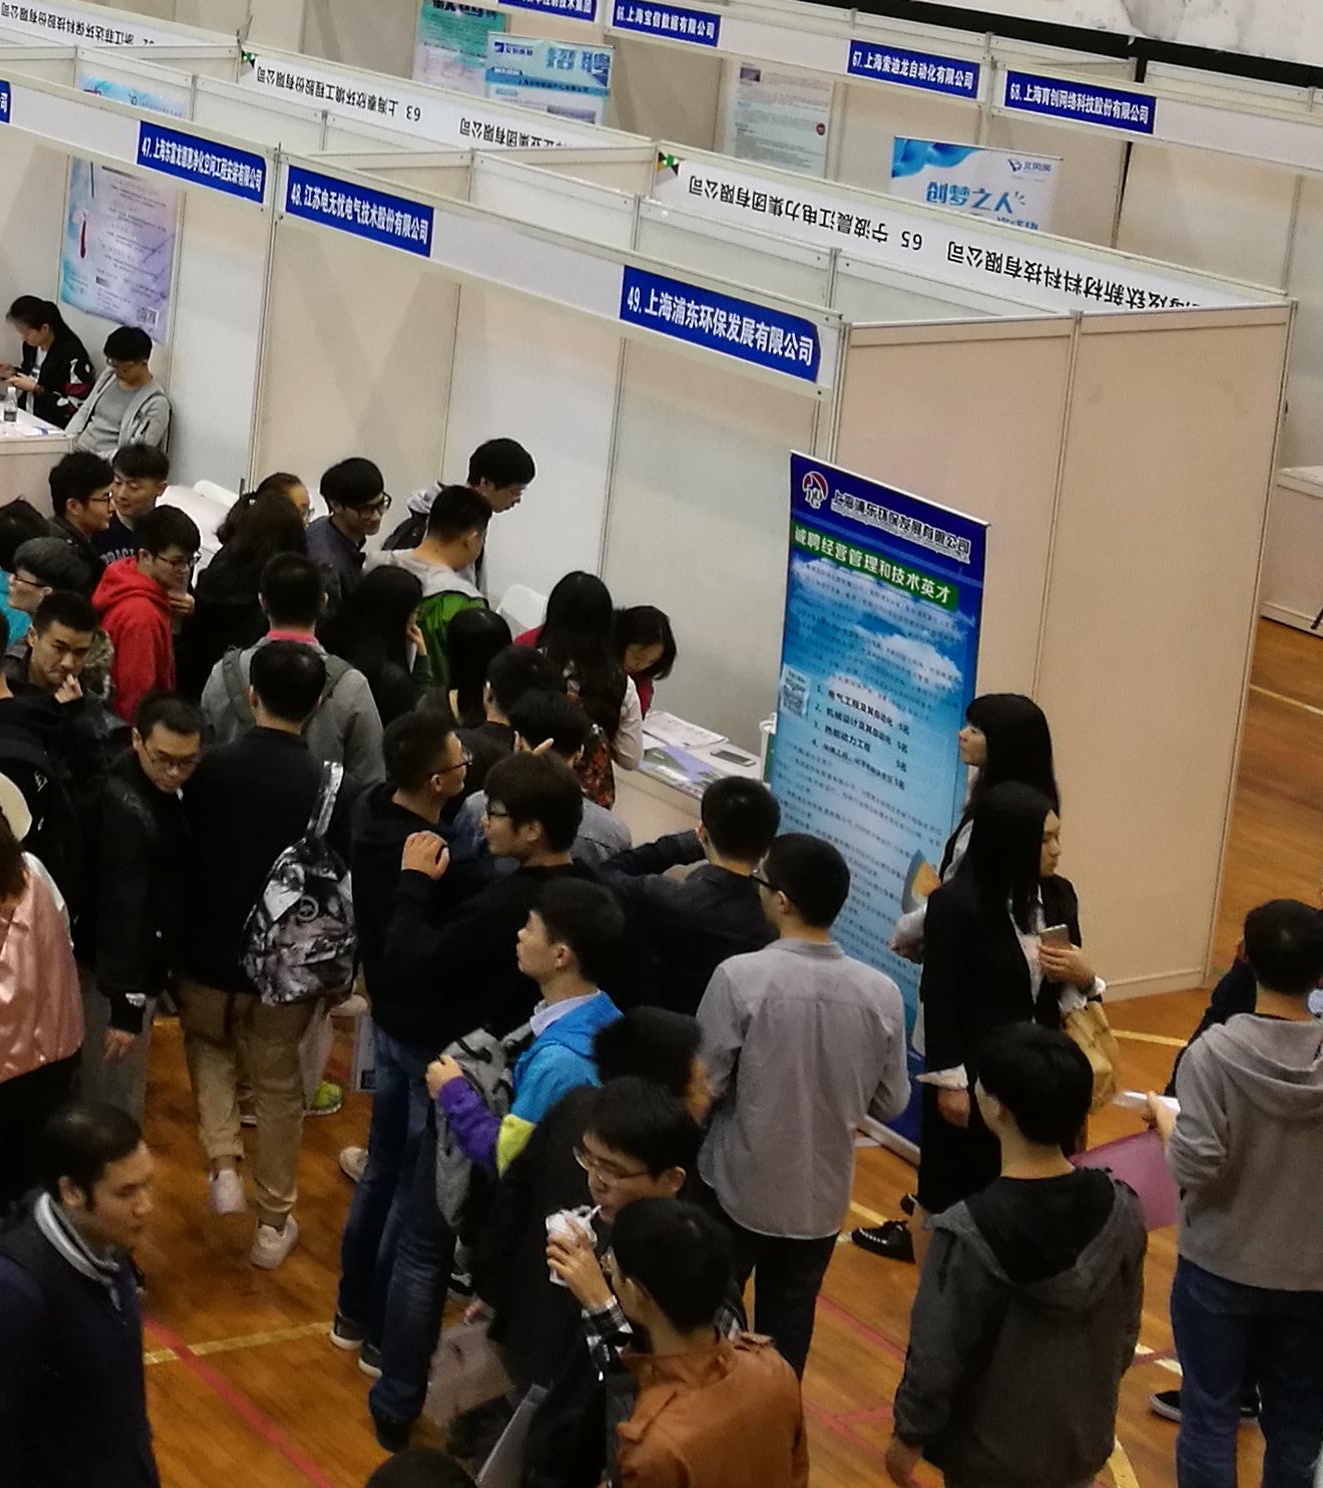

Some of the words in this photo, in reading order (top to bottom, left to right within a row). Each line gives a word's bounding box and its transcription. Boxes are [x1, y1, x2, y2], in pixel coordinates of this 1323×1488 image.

[406, 105, 421, 122] 63
[926, 181, 1014, 214] 创梦之人
[902, 231, 923, 253] 65
[627, 274, 816, 363] 49.上海浦东环保发展有限公司
[794, 525, 951, 603] 诚聘经营管理和技术英才
